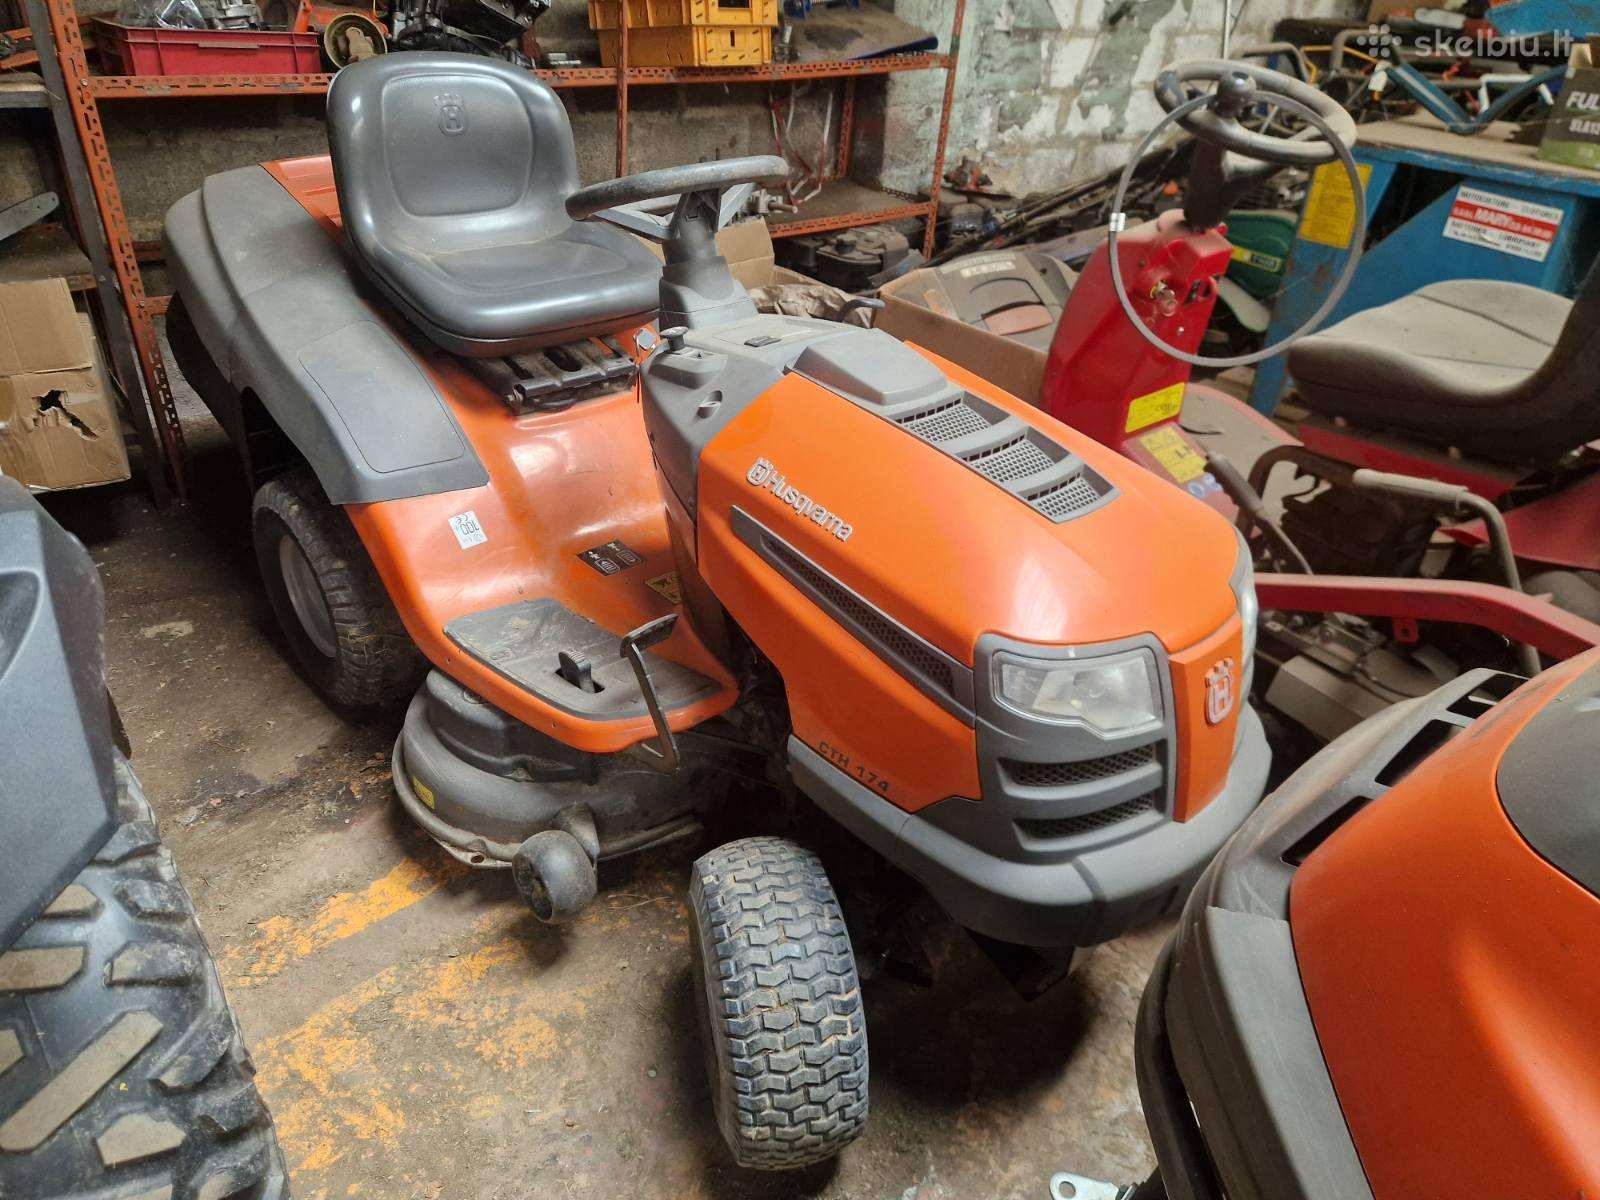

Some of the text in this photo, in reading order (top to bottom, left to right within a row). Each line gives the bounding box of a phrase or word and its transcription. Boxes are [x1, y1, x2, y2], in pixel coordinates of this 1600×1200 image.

[763, 470, 852, 542] Husqvarna
[820, 741, 889, 791] CTH 174
